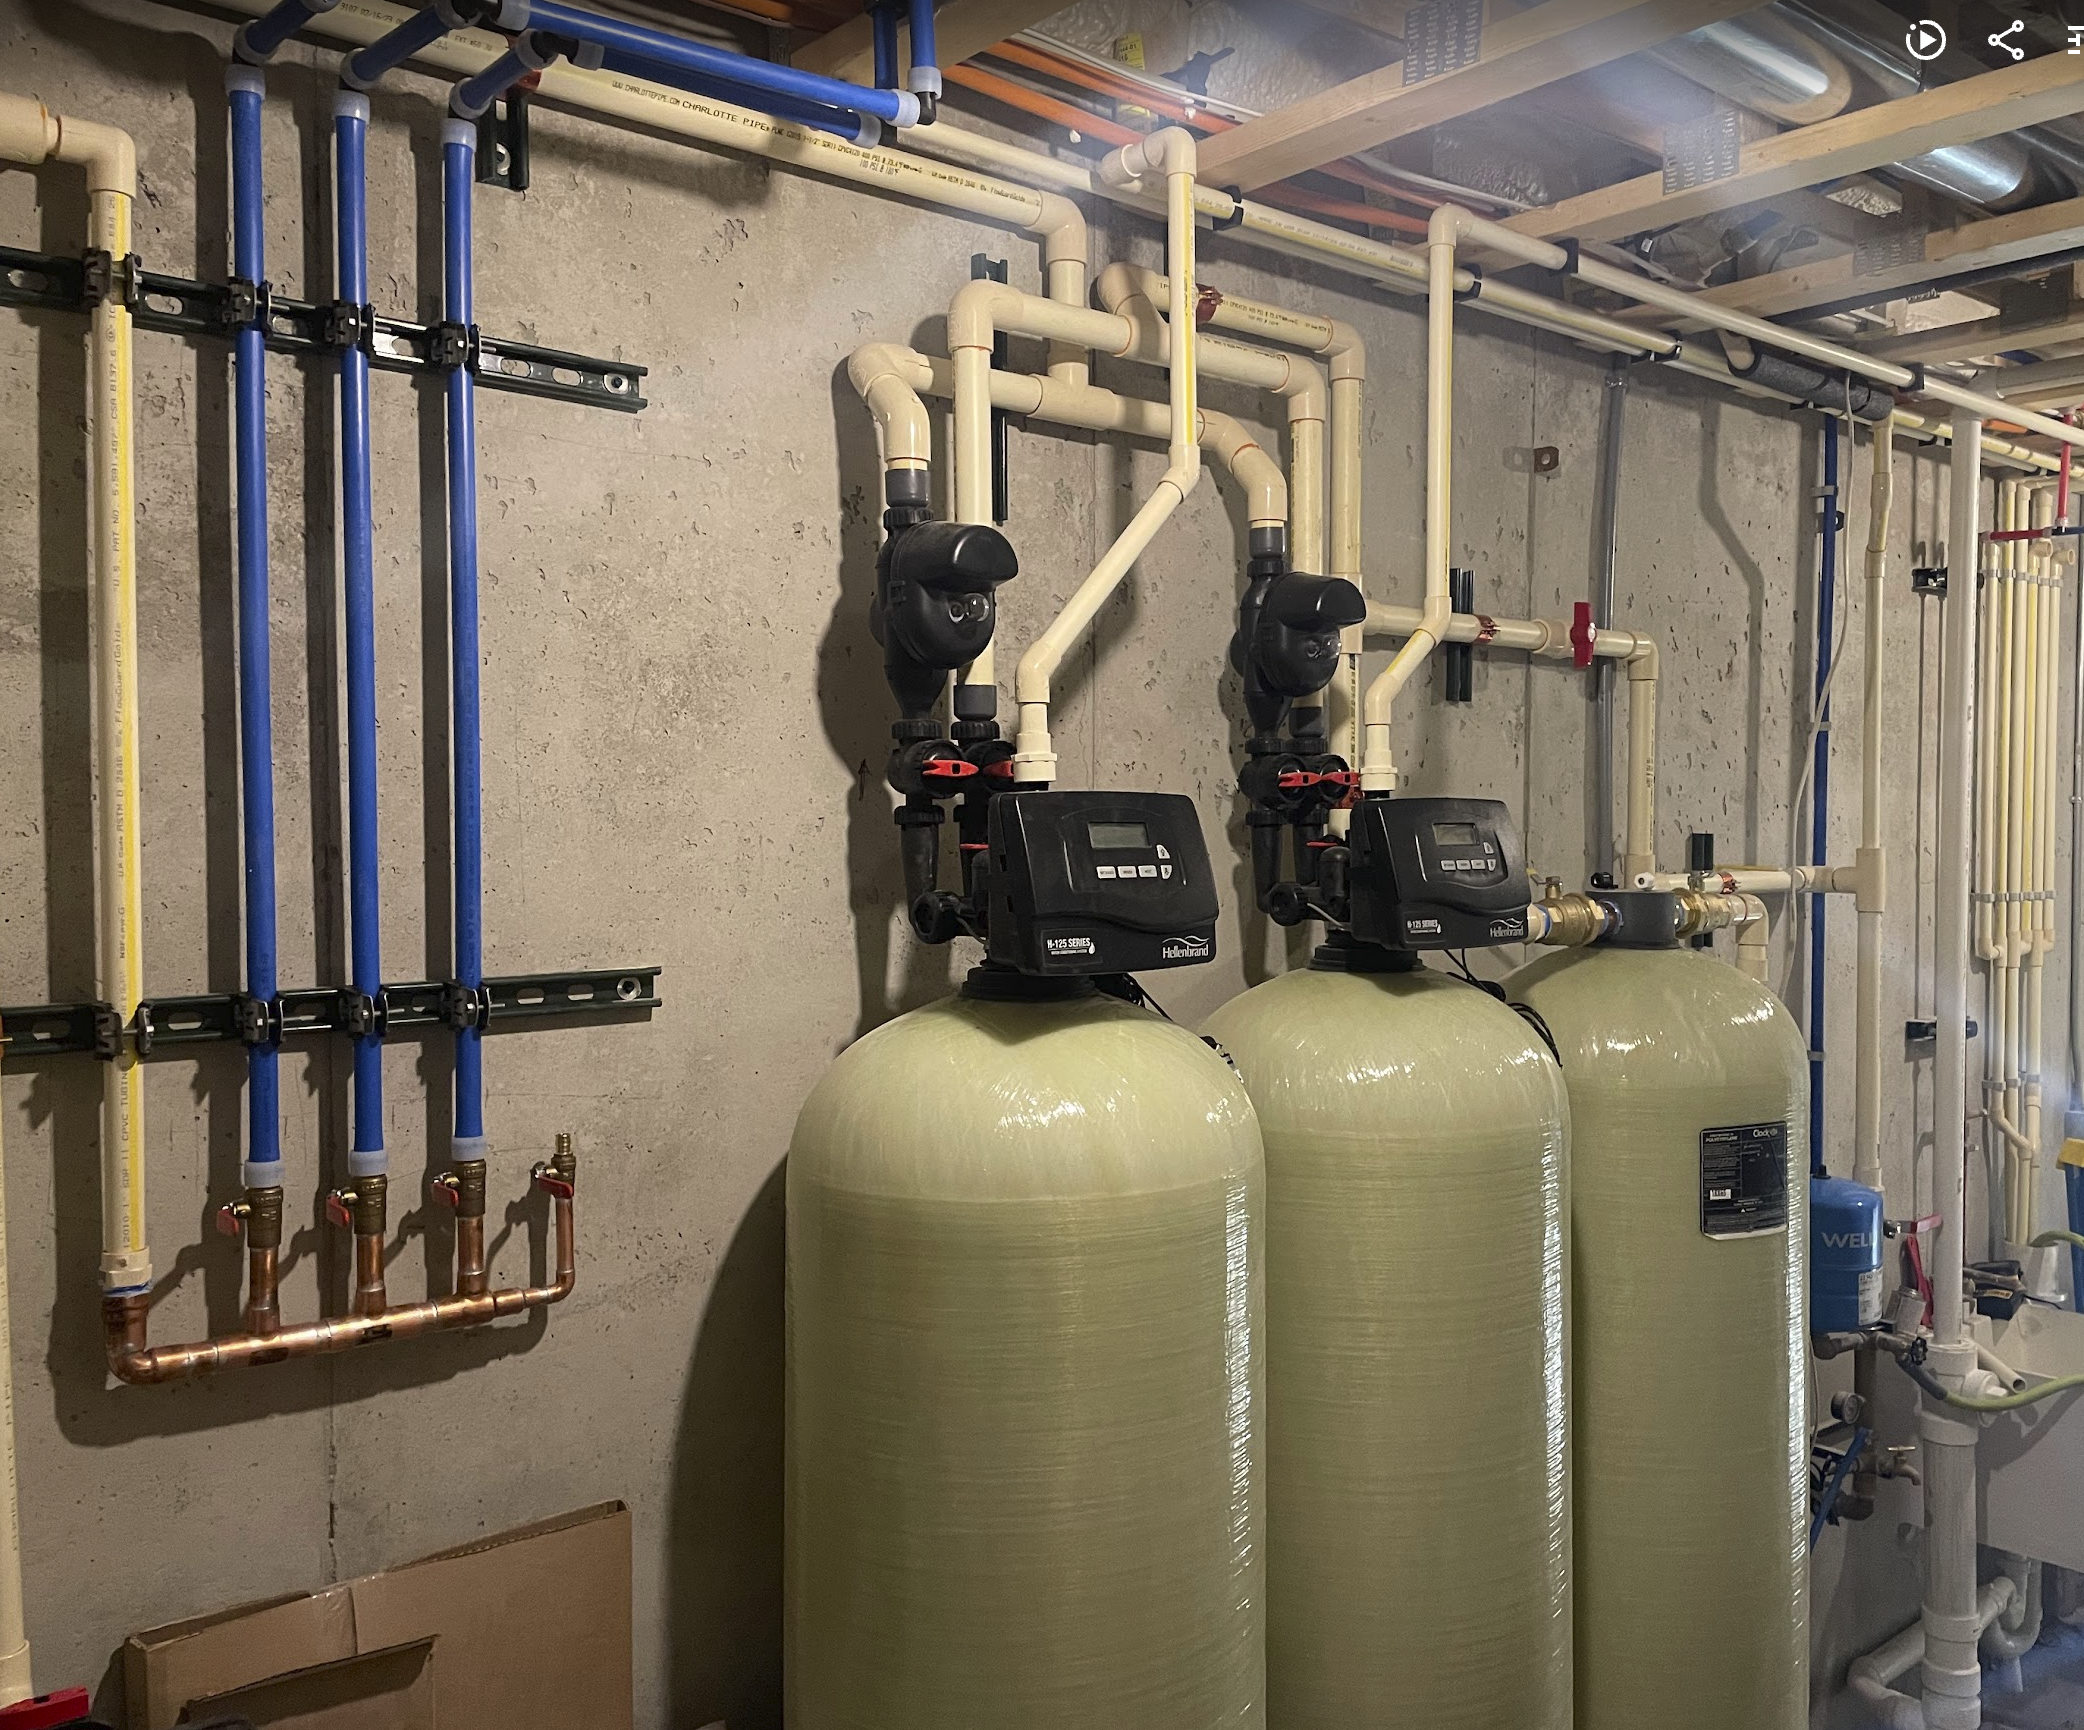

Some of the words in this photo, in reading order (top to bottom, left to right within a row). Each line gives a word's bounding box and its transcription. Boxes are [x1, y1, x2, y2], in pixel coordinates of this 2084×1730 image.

[682, 100, 738, 123] CHARLOTTE
[869, 161, 878, 171] PSI
[116, 802, 124, 831] ASTM
[1068, 937, 1091, 948] SERIES
[1162, 943, 1209, 959] Hellenbrand
[121, 1112, 129, 1140] CPVC
